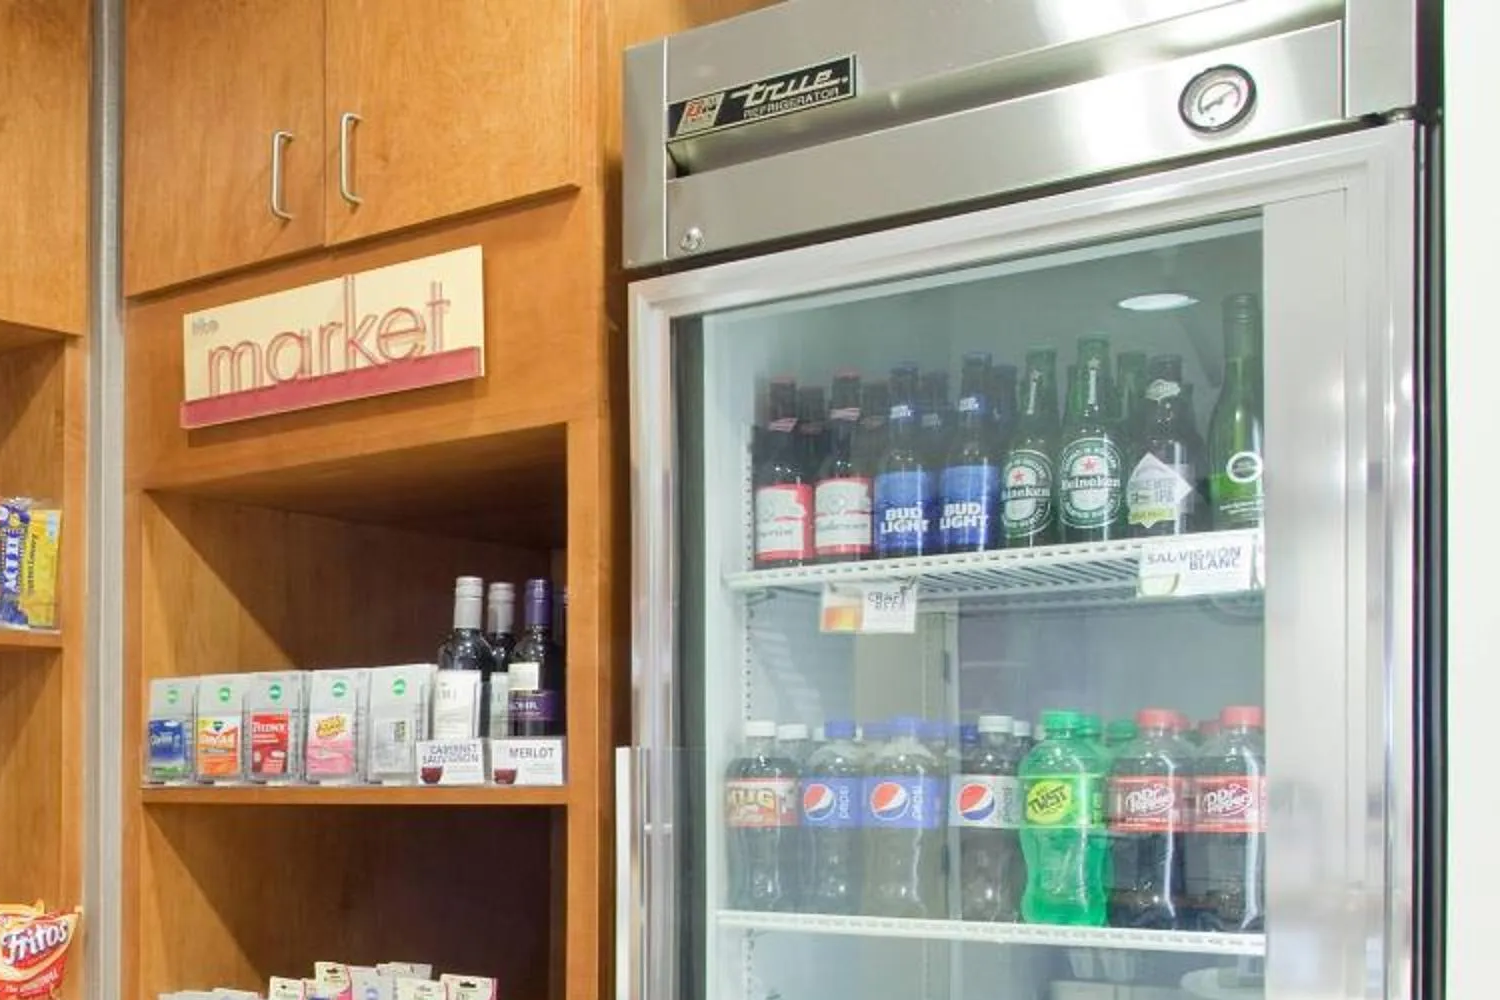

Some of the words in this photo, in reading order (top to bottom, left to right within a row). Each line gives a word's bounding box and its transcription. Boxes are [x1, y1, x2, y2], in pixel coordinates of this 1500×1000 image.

[208, 274, 451, 398] market
[885, 505, 923, 521] BUD
[943, 501, 984, 516] BUD
[880, 518, 929, 534] LIGHT
[939, 514, 988, 530] LIGHT
[1147, 546, 1242, 564] SAUVIGNON
[1188, 557, 1240, 571] BLANC
[508, 746, 555, 760] MERLOT
[0, 919, 69, 966] Fritos
